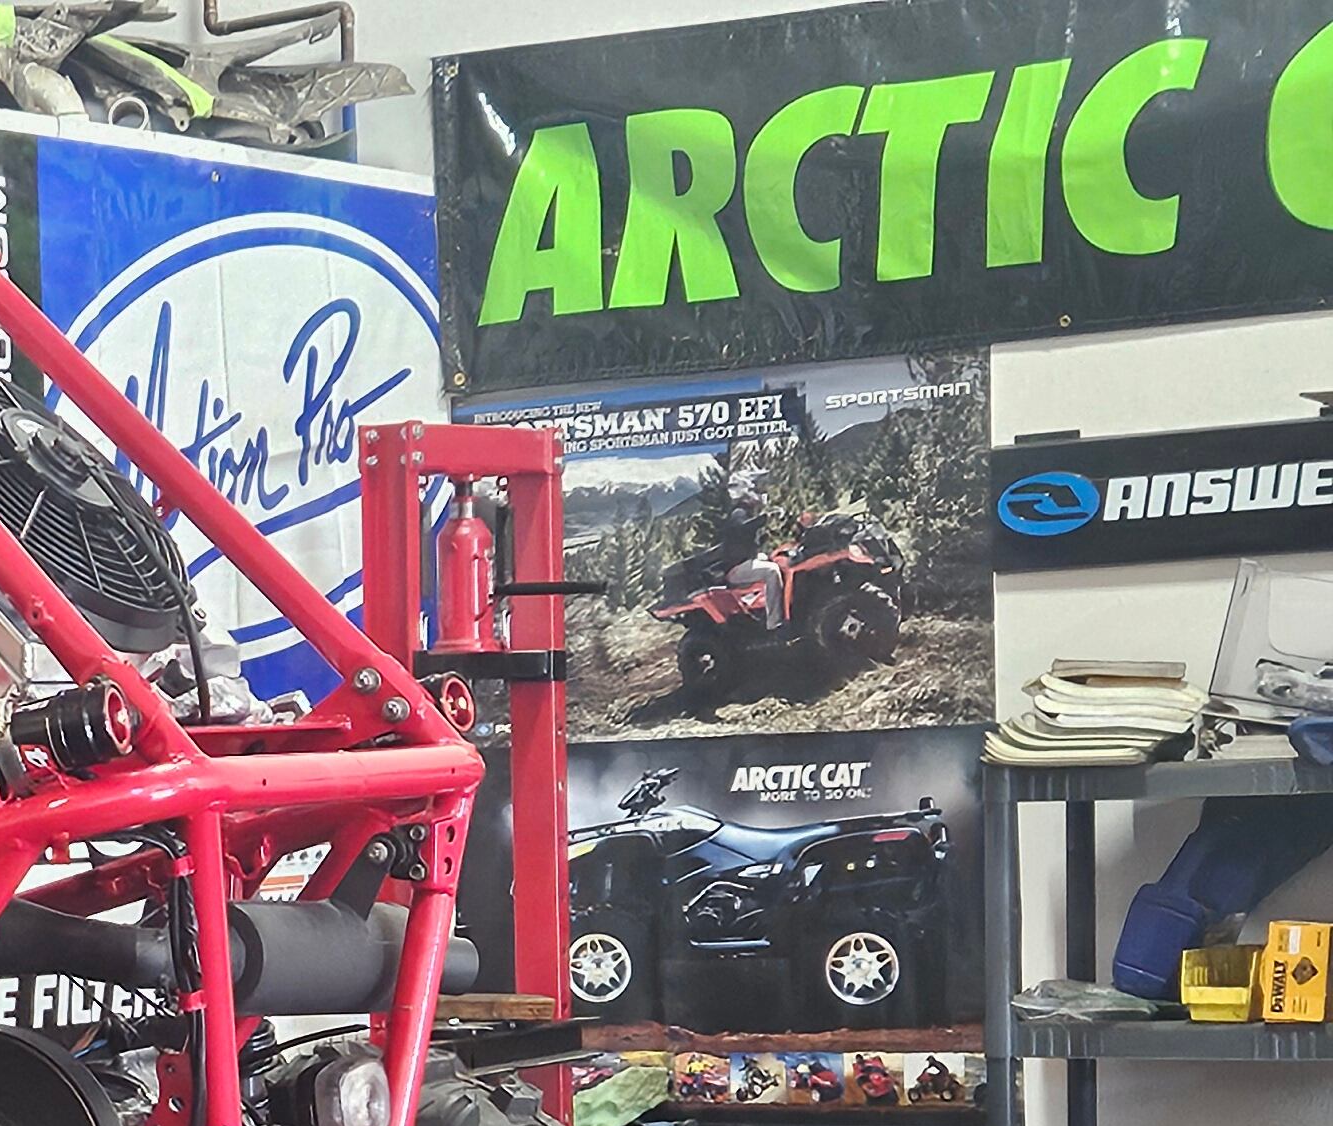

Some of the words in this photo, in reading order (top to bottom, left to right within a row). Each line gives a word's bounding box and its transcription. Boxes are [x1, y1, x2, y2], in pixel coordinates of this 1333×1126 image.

[477, 38, 1209, 327] ARCTIC
[283, 297, 412, 487] Pro
[825, 381, 971, 410] SPORTSMAN
[678, 401, 729, 428] 570
[738, 395, 783, 422] EFI
[589, 431, 669, 452] SPORTSMAN
[671, 429, 701, 445] JUST
[703, 425, 734, 440] GOT
[730, 764, 817, 792] ARCTIC
[820, 762, 868, 788] CAT
